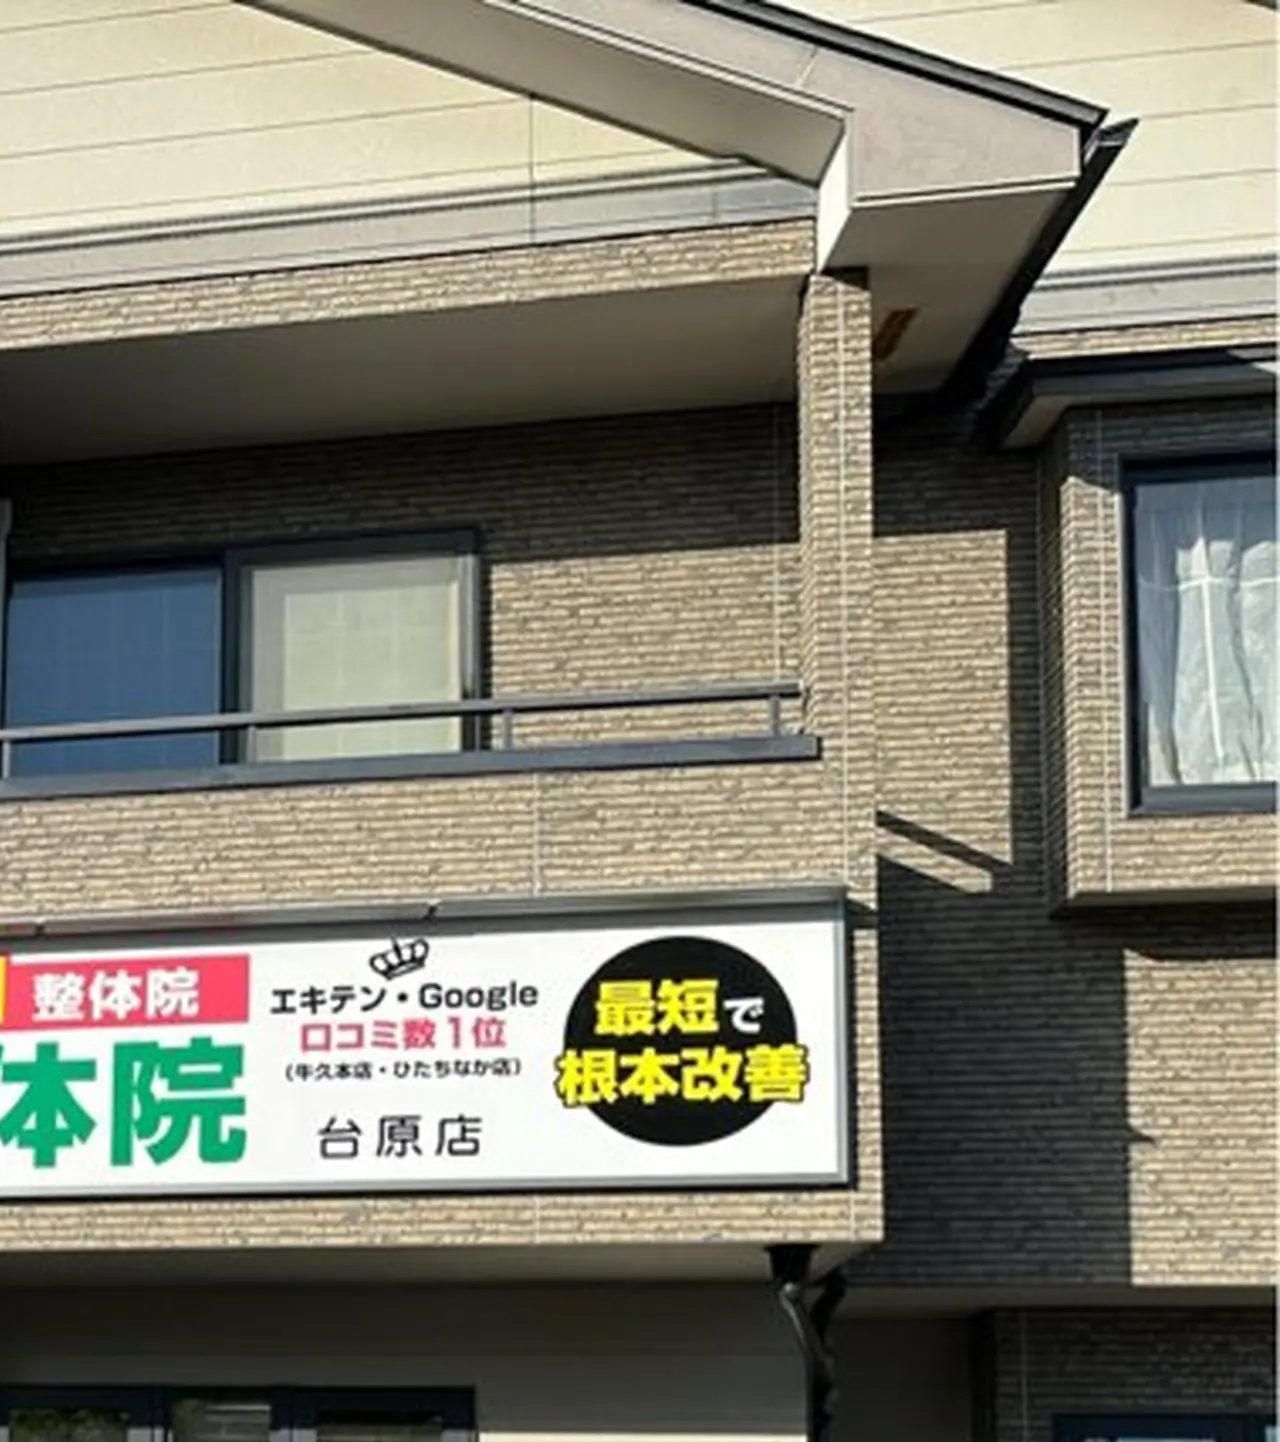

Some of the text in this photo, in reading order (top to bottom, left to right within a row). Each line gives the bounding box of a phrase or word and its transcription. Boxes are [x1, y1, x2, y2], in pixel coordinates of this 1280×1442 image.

[31, 968, 200, 1021] 整体院
[595, 979, 764, 1035] 最短で
[300, 1017, 506, 1052] 口コミ数1位
[557, 1044, 808, 1104] 根本改善
[318, 1114, 483, 1159] 台原店
